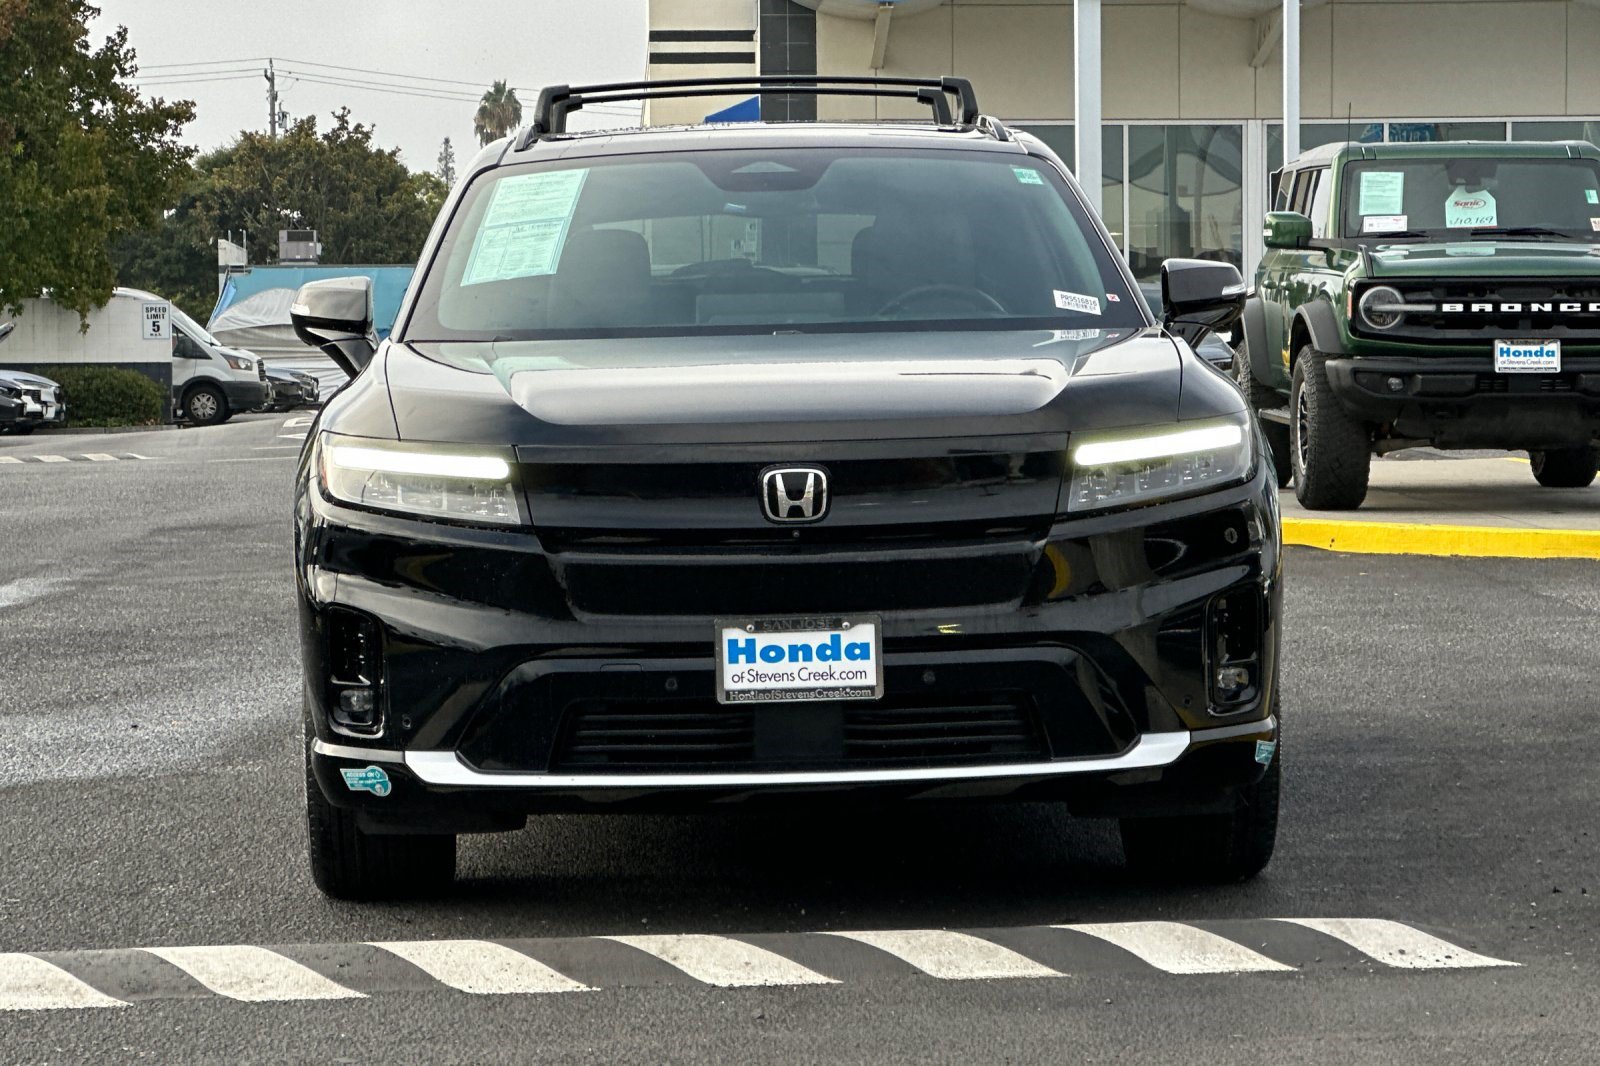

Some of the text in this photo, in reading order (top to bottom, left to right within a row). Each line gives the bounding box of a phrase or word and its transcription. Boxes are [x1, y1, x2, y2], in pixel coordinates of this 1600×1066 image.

[152, 320, 160, 332] 5
[1499, 346, 1556, 358] Honda
[763, 619, 834, 631] SAN JOSE
[727, 633, 871, 664] Honda
[731, 665, 867, 684] of Stevens Creek.com
